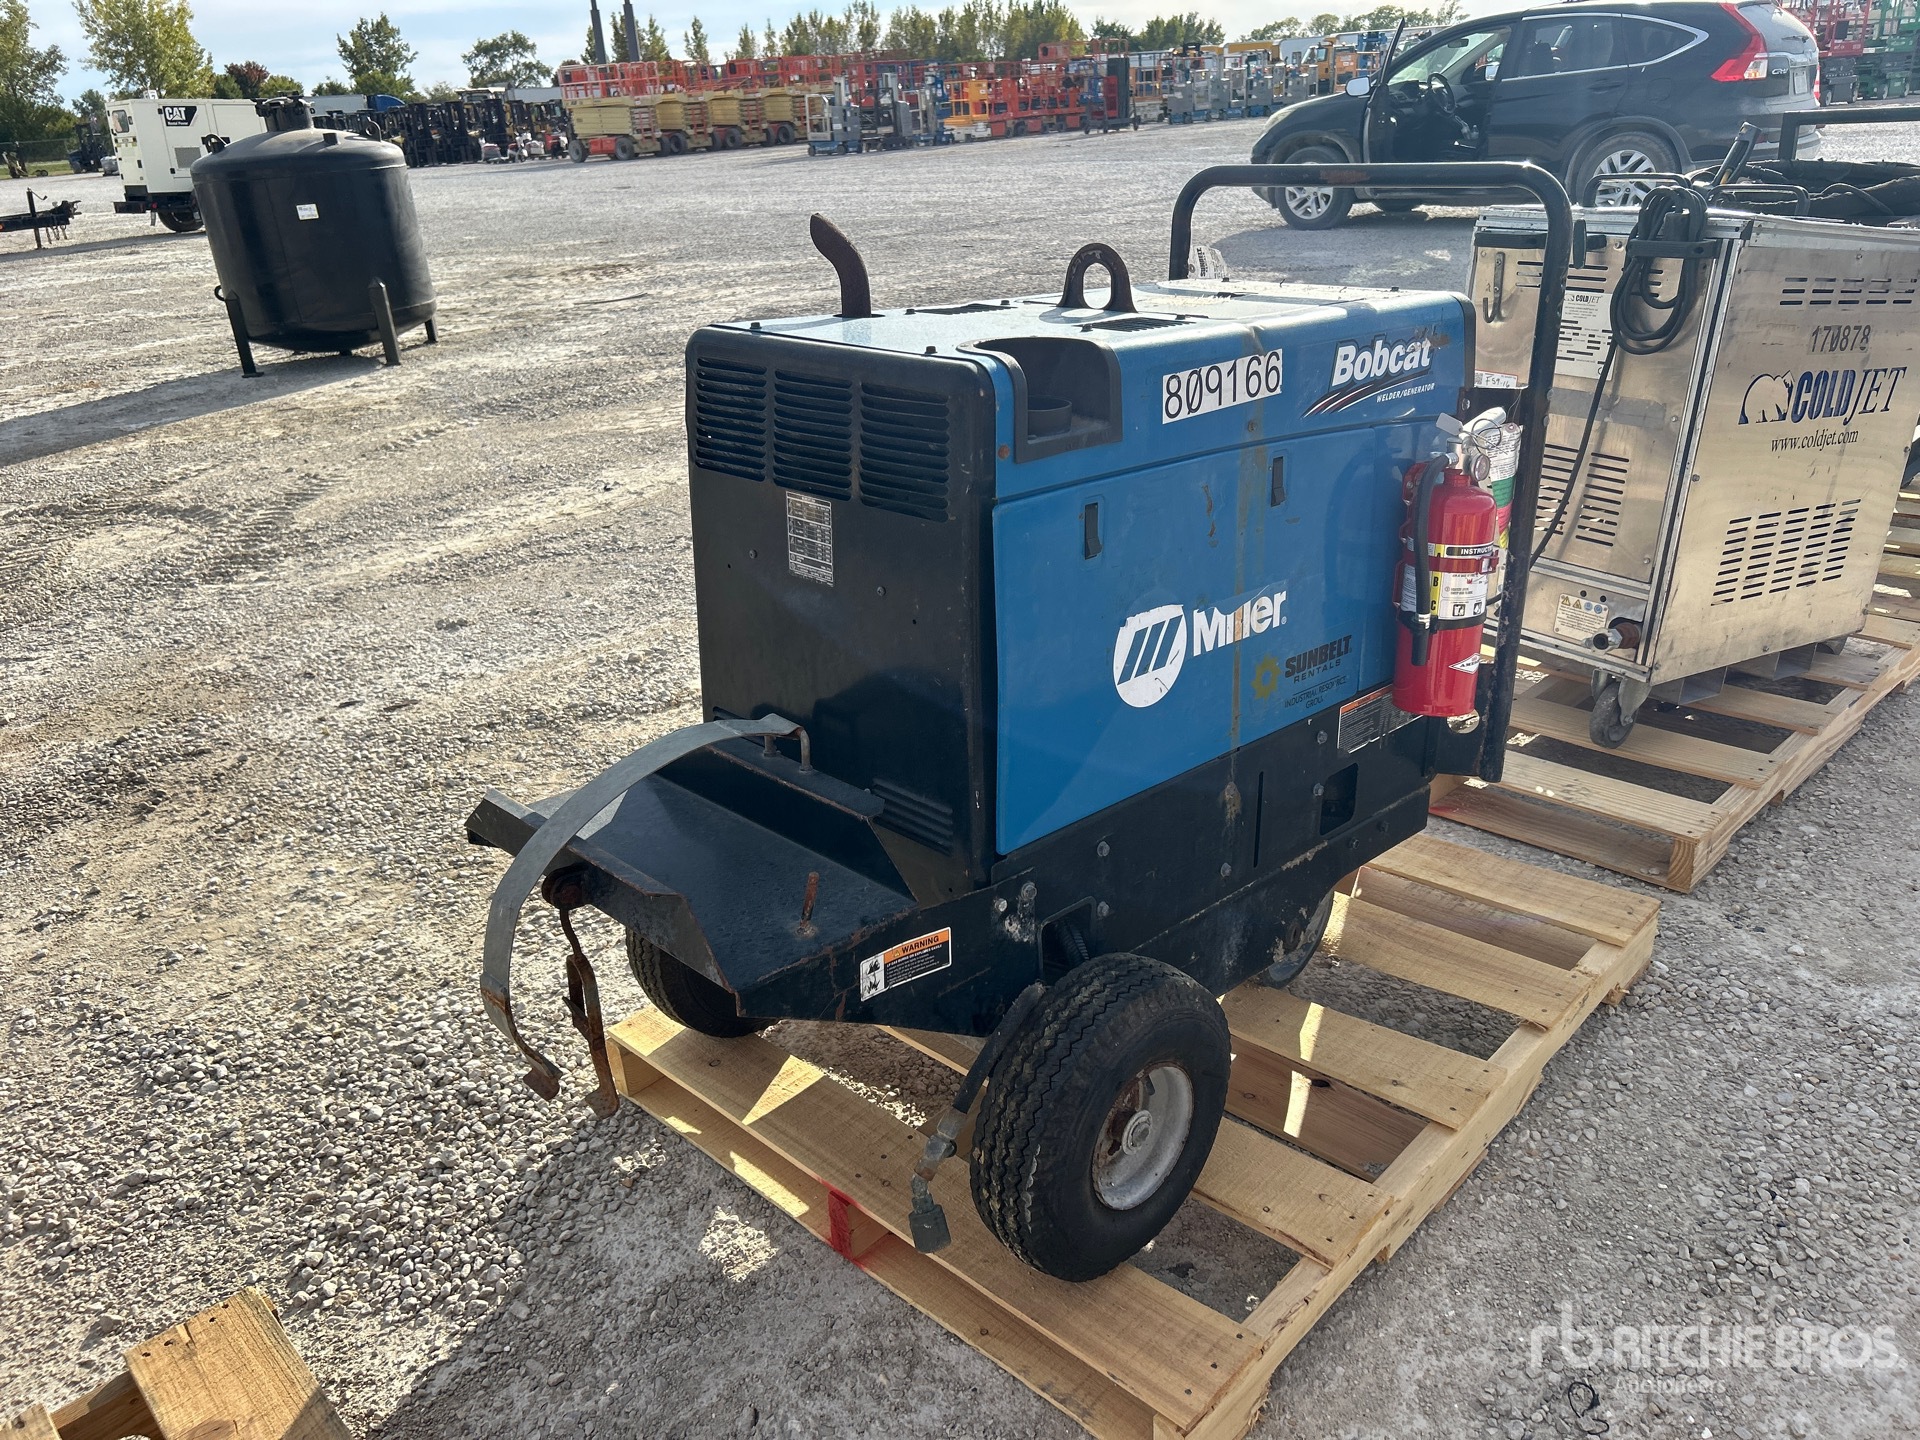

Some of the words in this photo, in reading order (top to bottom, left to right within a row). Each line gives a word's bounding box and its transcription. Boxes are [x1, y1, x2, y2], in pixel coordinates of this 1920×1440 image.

[165, 107, 185, 120] CAT
[1197, 247, 1206, 277] SUNBELT
[1331, 337, 1432, 387] Bobcat
[1165, 351, 1281, 419] 809166
[1376, 383, 1435, 403] WELDER/GENERATOR
[1771, 429, 1859, 452] www.coldjet.com
[1433, 577, 1439, 587] B
[1431, 600, 1436, 610] C
[1284, 634, 1352, 678] SUNBELT
[1294, 658, 1341, 684] RENTALS
[902, 936, 939, 954] WARNING
